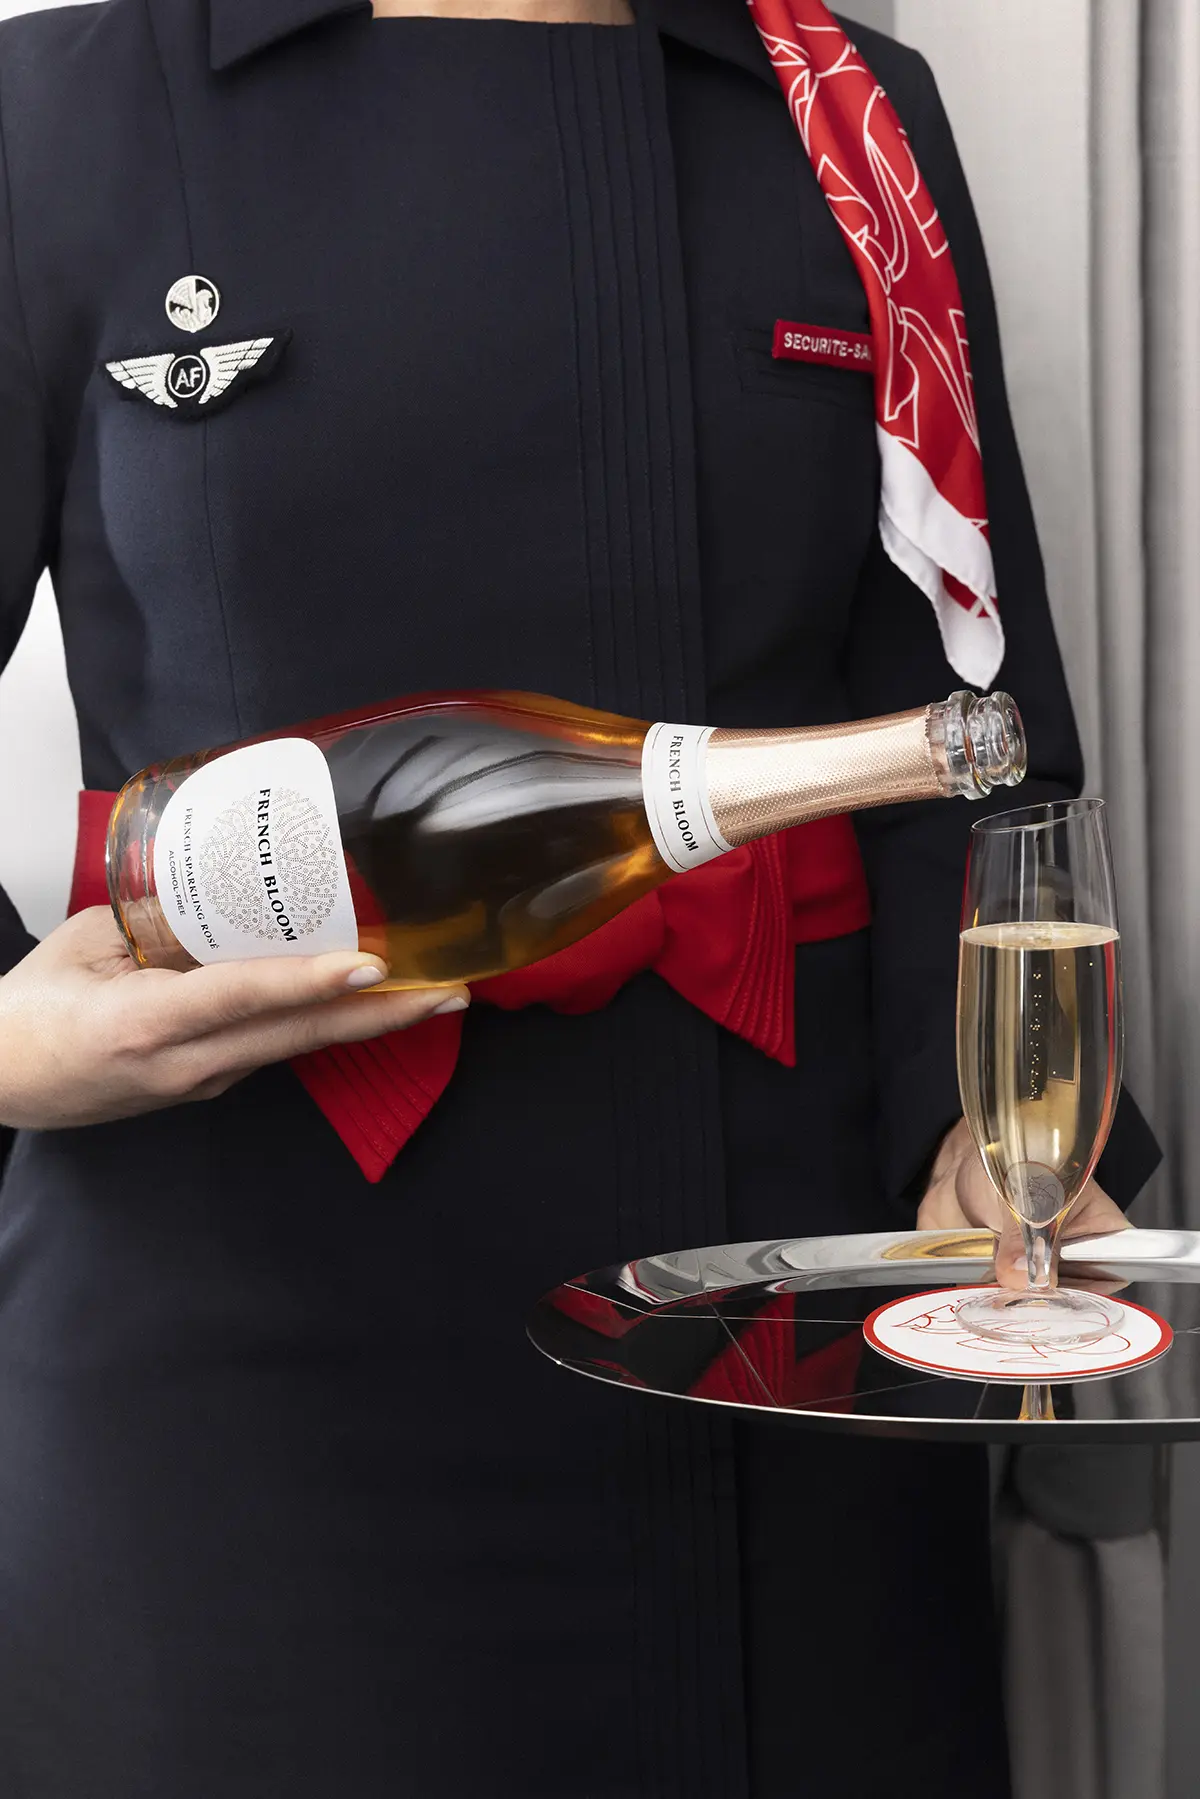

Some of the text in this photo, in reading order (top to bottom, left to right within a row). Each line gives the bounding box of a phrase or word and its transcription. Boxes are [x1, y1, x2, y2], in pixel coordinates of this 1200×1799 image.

[175, 367, 202, 390] AF
[784, 332, 872, 360] SECURITE-SA
[669, 735, 699, 851] FRENCH BLOOM
[168, 850, 187, 916] ALCOHOL-FREE
[183, 807, 220, 950] FRENCH SPARKLING ROSÉ
[257, 788, 298, 942] FRENCH BLOOM
